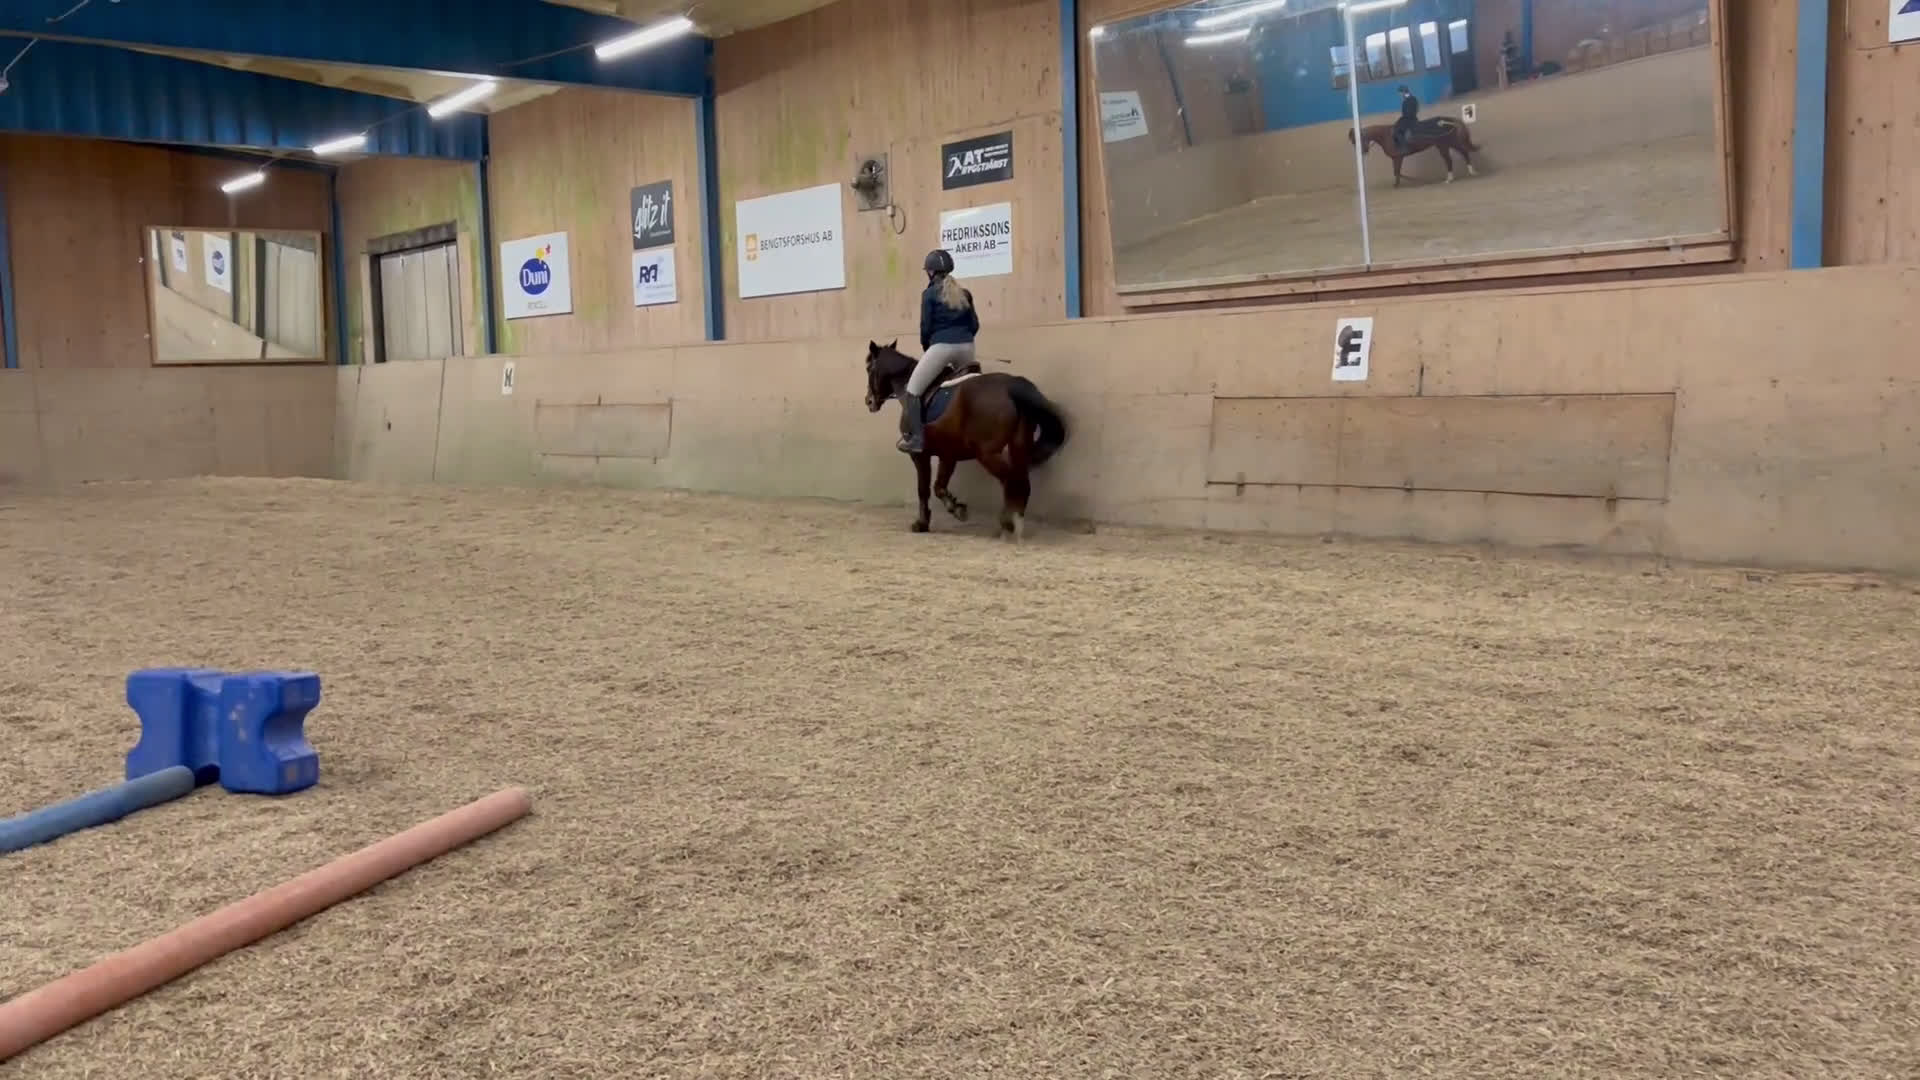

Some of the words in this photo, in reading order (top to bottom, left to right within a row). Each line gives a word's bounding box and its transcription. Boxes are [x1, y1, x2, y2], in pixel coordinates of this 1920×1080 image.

[634, 194, 658, 239] glitz
[660, 190, 671, 226] it
[760, 232, 820, 251] BENGTSFORSHUS
[822, 230, 833, 241] AB
[942, 221, 1010, 242] FREDRIKSSONS
[983, 240, 996, 251] AB
[522, 265, 548, 287] Duni
